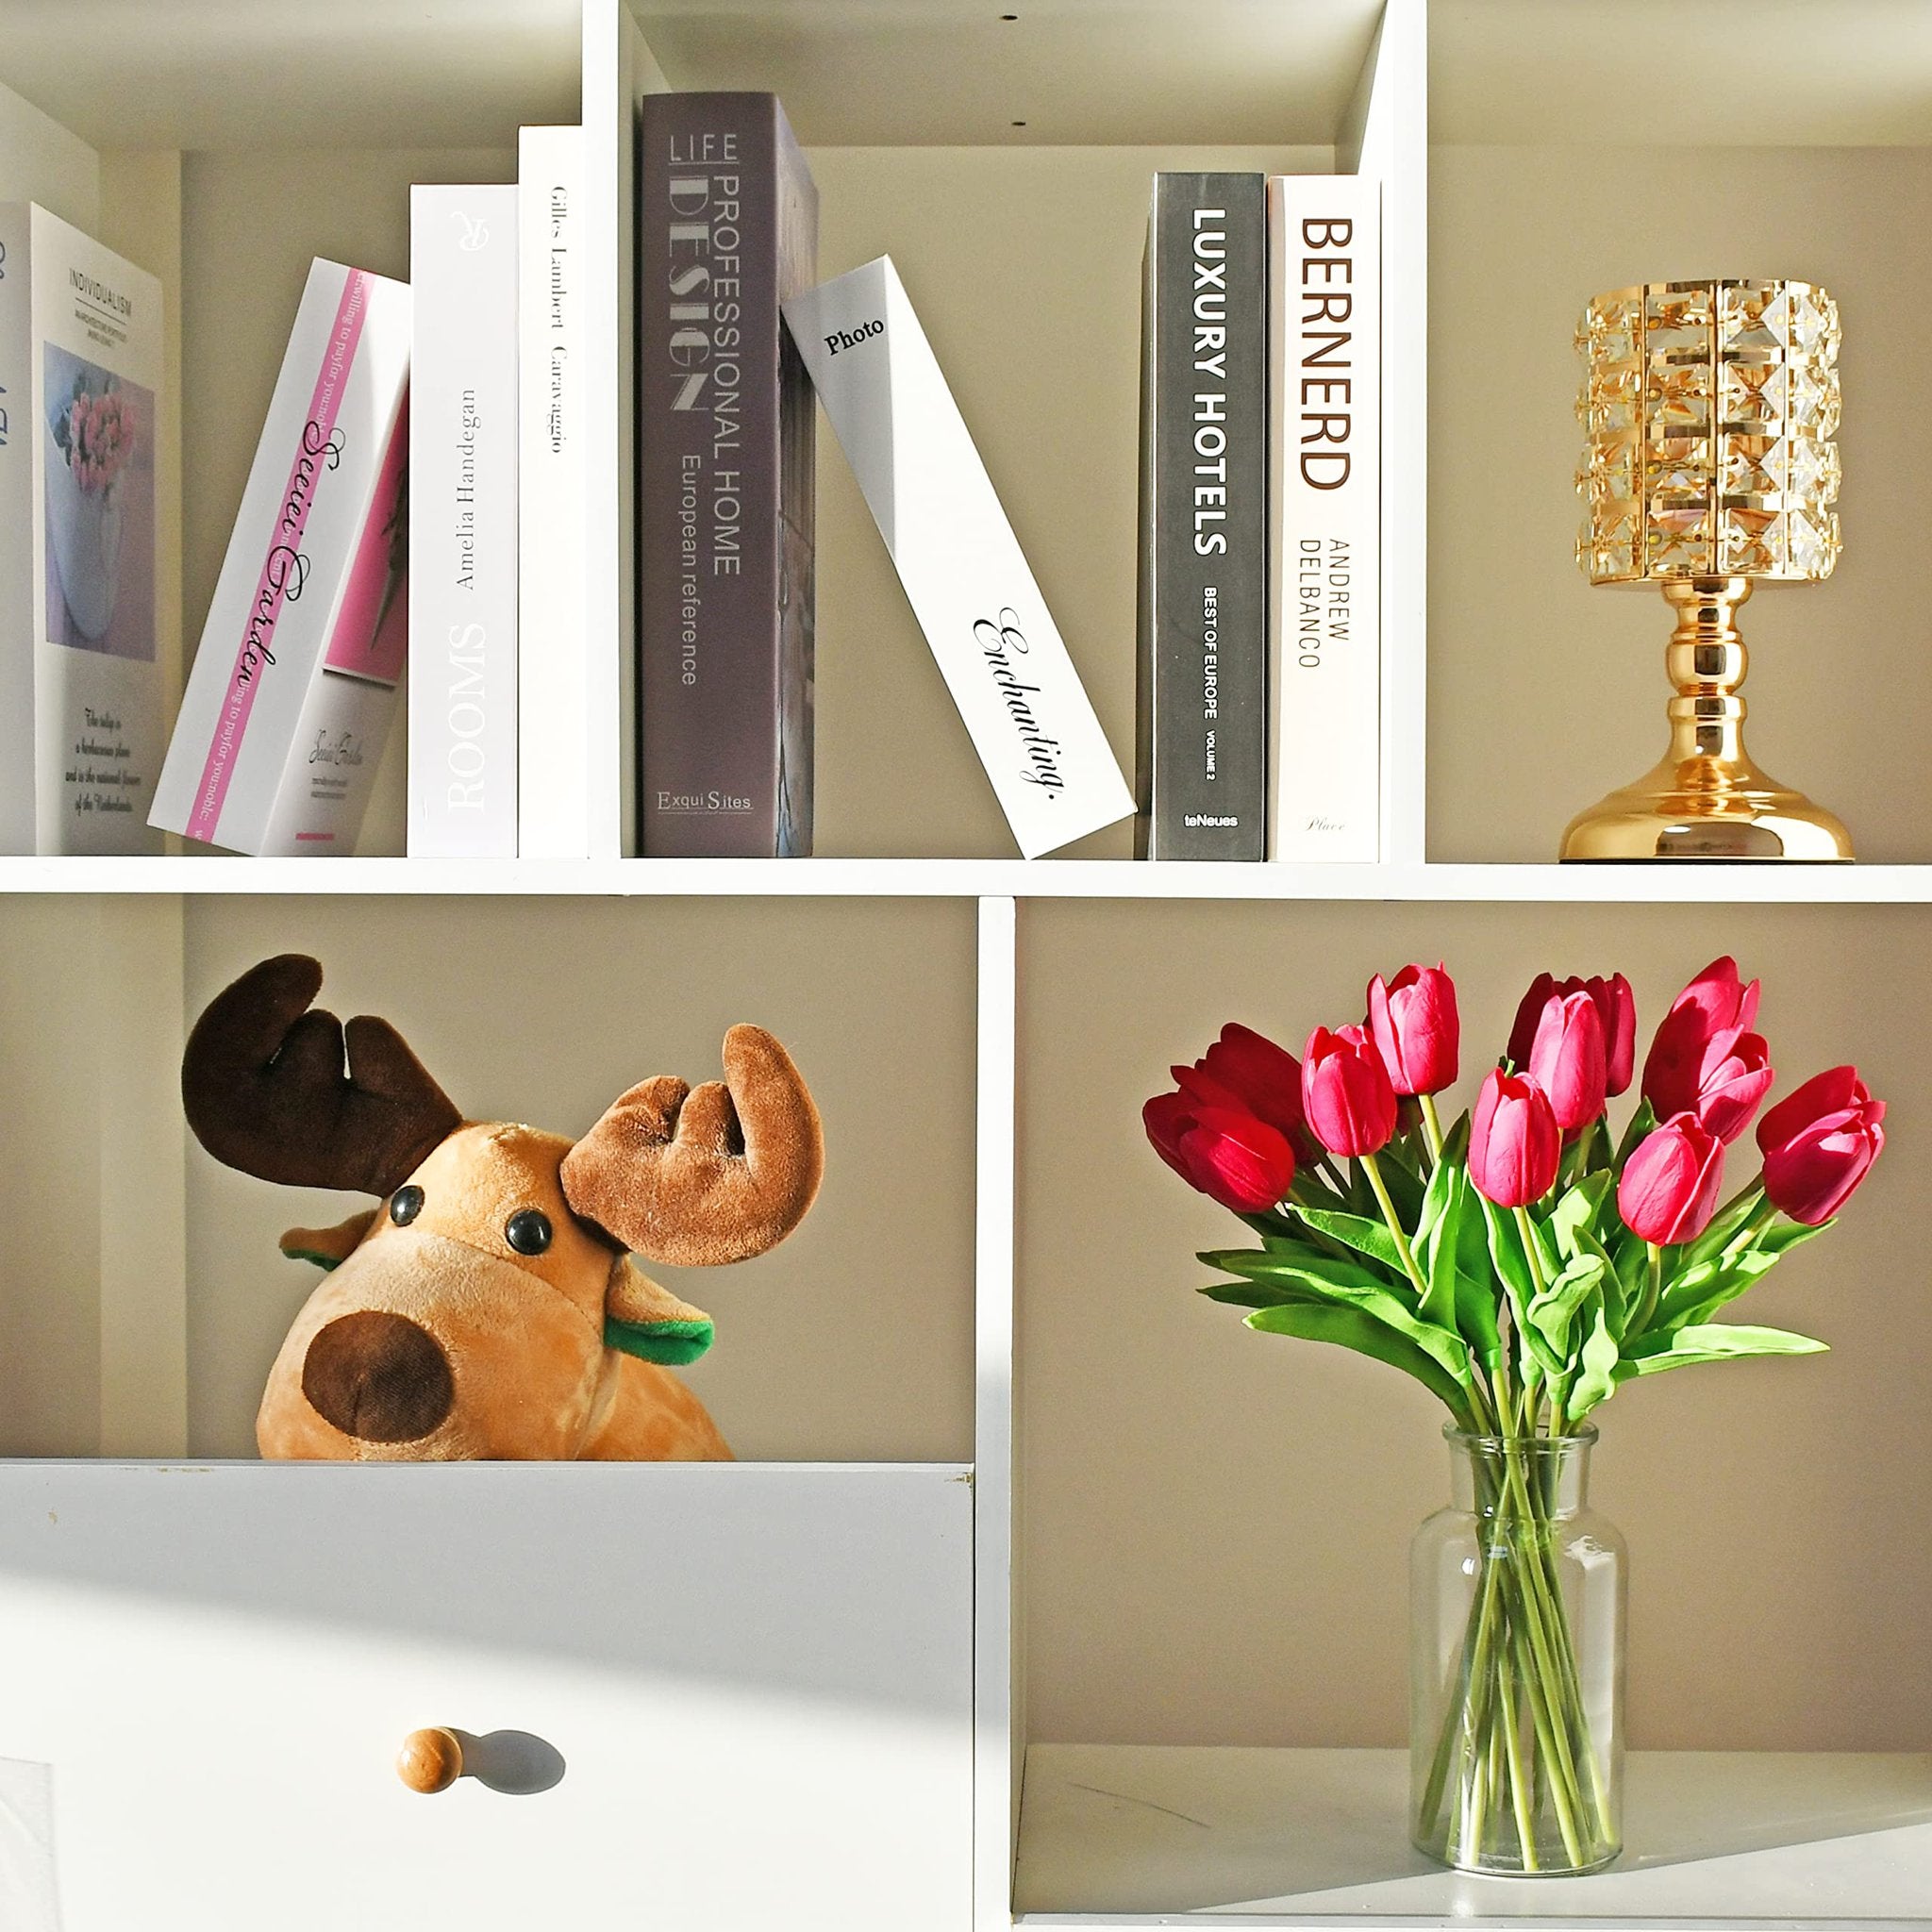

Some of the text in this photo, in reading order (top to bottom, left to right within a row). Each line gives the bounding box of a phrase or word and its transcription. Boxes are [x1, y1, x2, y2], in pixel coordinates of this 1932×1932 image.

[669, 133, 739, 162] LIFE
[69, 267, 131, 317] INDIVIDUALISM
[340, 327, 352, 341] to
[546, 186, 568, 454] Gilles Lambert Caravaggio
[668, 175, 710, 411] DESIGN
[824, 320, 884, 356] Photo
[1300, 218, 1354, 491] BERNERD
[713, 175, 741, 575] PROFESSIONAL HOME
[1193, 208, 1227, 557] LUXURY HOTELS
[456, 389, 482, 591] Amelia Handegan
[238, 545, 311, 688] Garden
[678, 455, 701, 686] European reference
[1298, 540, 1323, 669] DELBANCO
[1328, 539, 1350, 641] ANDREW
[229, 707, 242, 720] to
[448, 623, 489, 814] ROOMS
[973, 606, 1072, 800] Enchanting.
[1204, 587, 1218, 720] BEST OF EUROPE
[1184, 813, 1240, 827] teNeues
[1205, 729, 1216, 773] VOLUME
